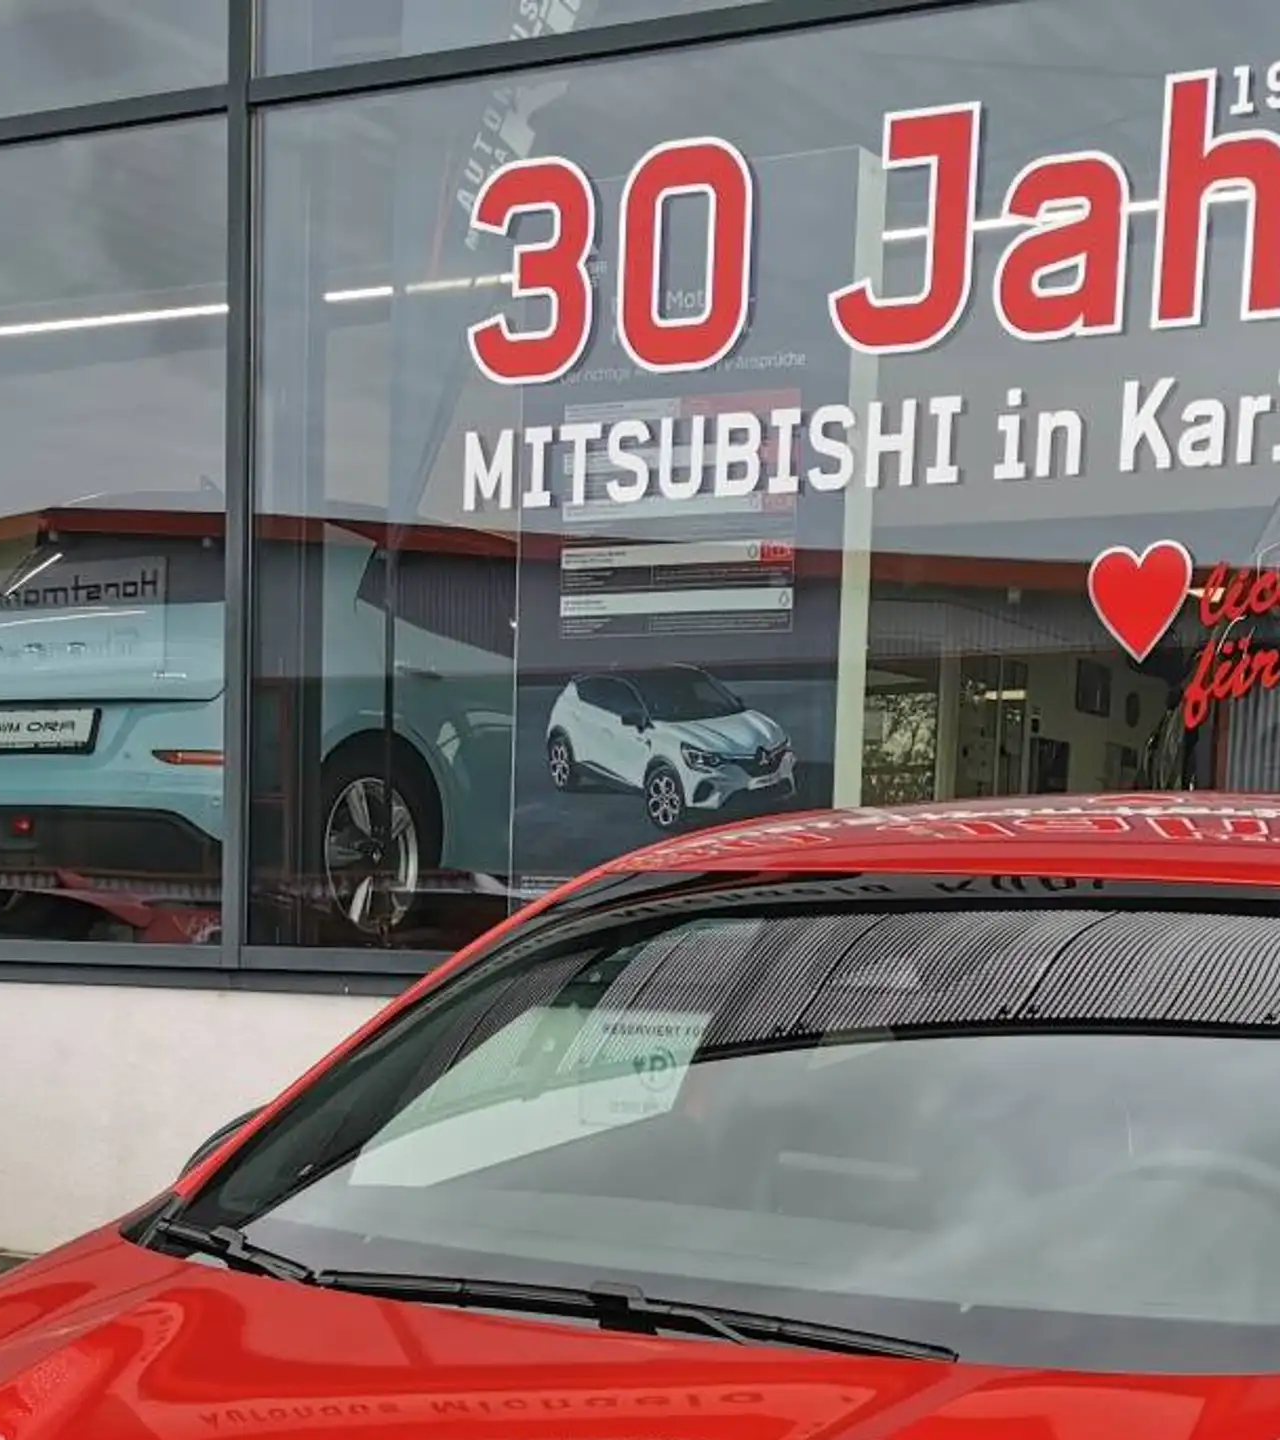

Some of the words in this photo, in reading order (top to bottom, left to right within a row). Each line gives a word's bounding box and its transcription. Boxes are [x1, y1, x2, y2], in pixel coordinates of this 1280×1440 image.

[467, 136, 753, 385] 30
[462, 395, 963, 512] MITSUBISHI
[993, 388, 1082, 481] in
